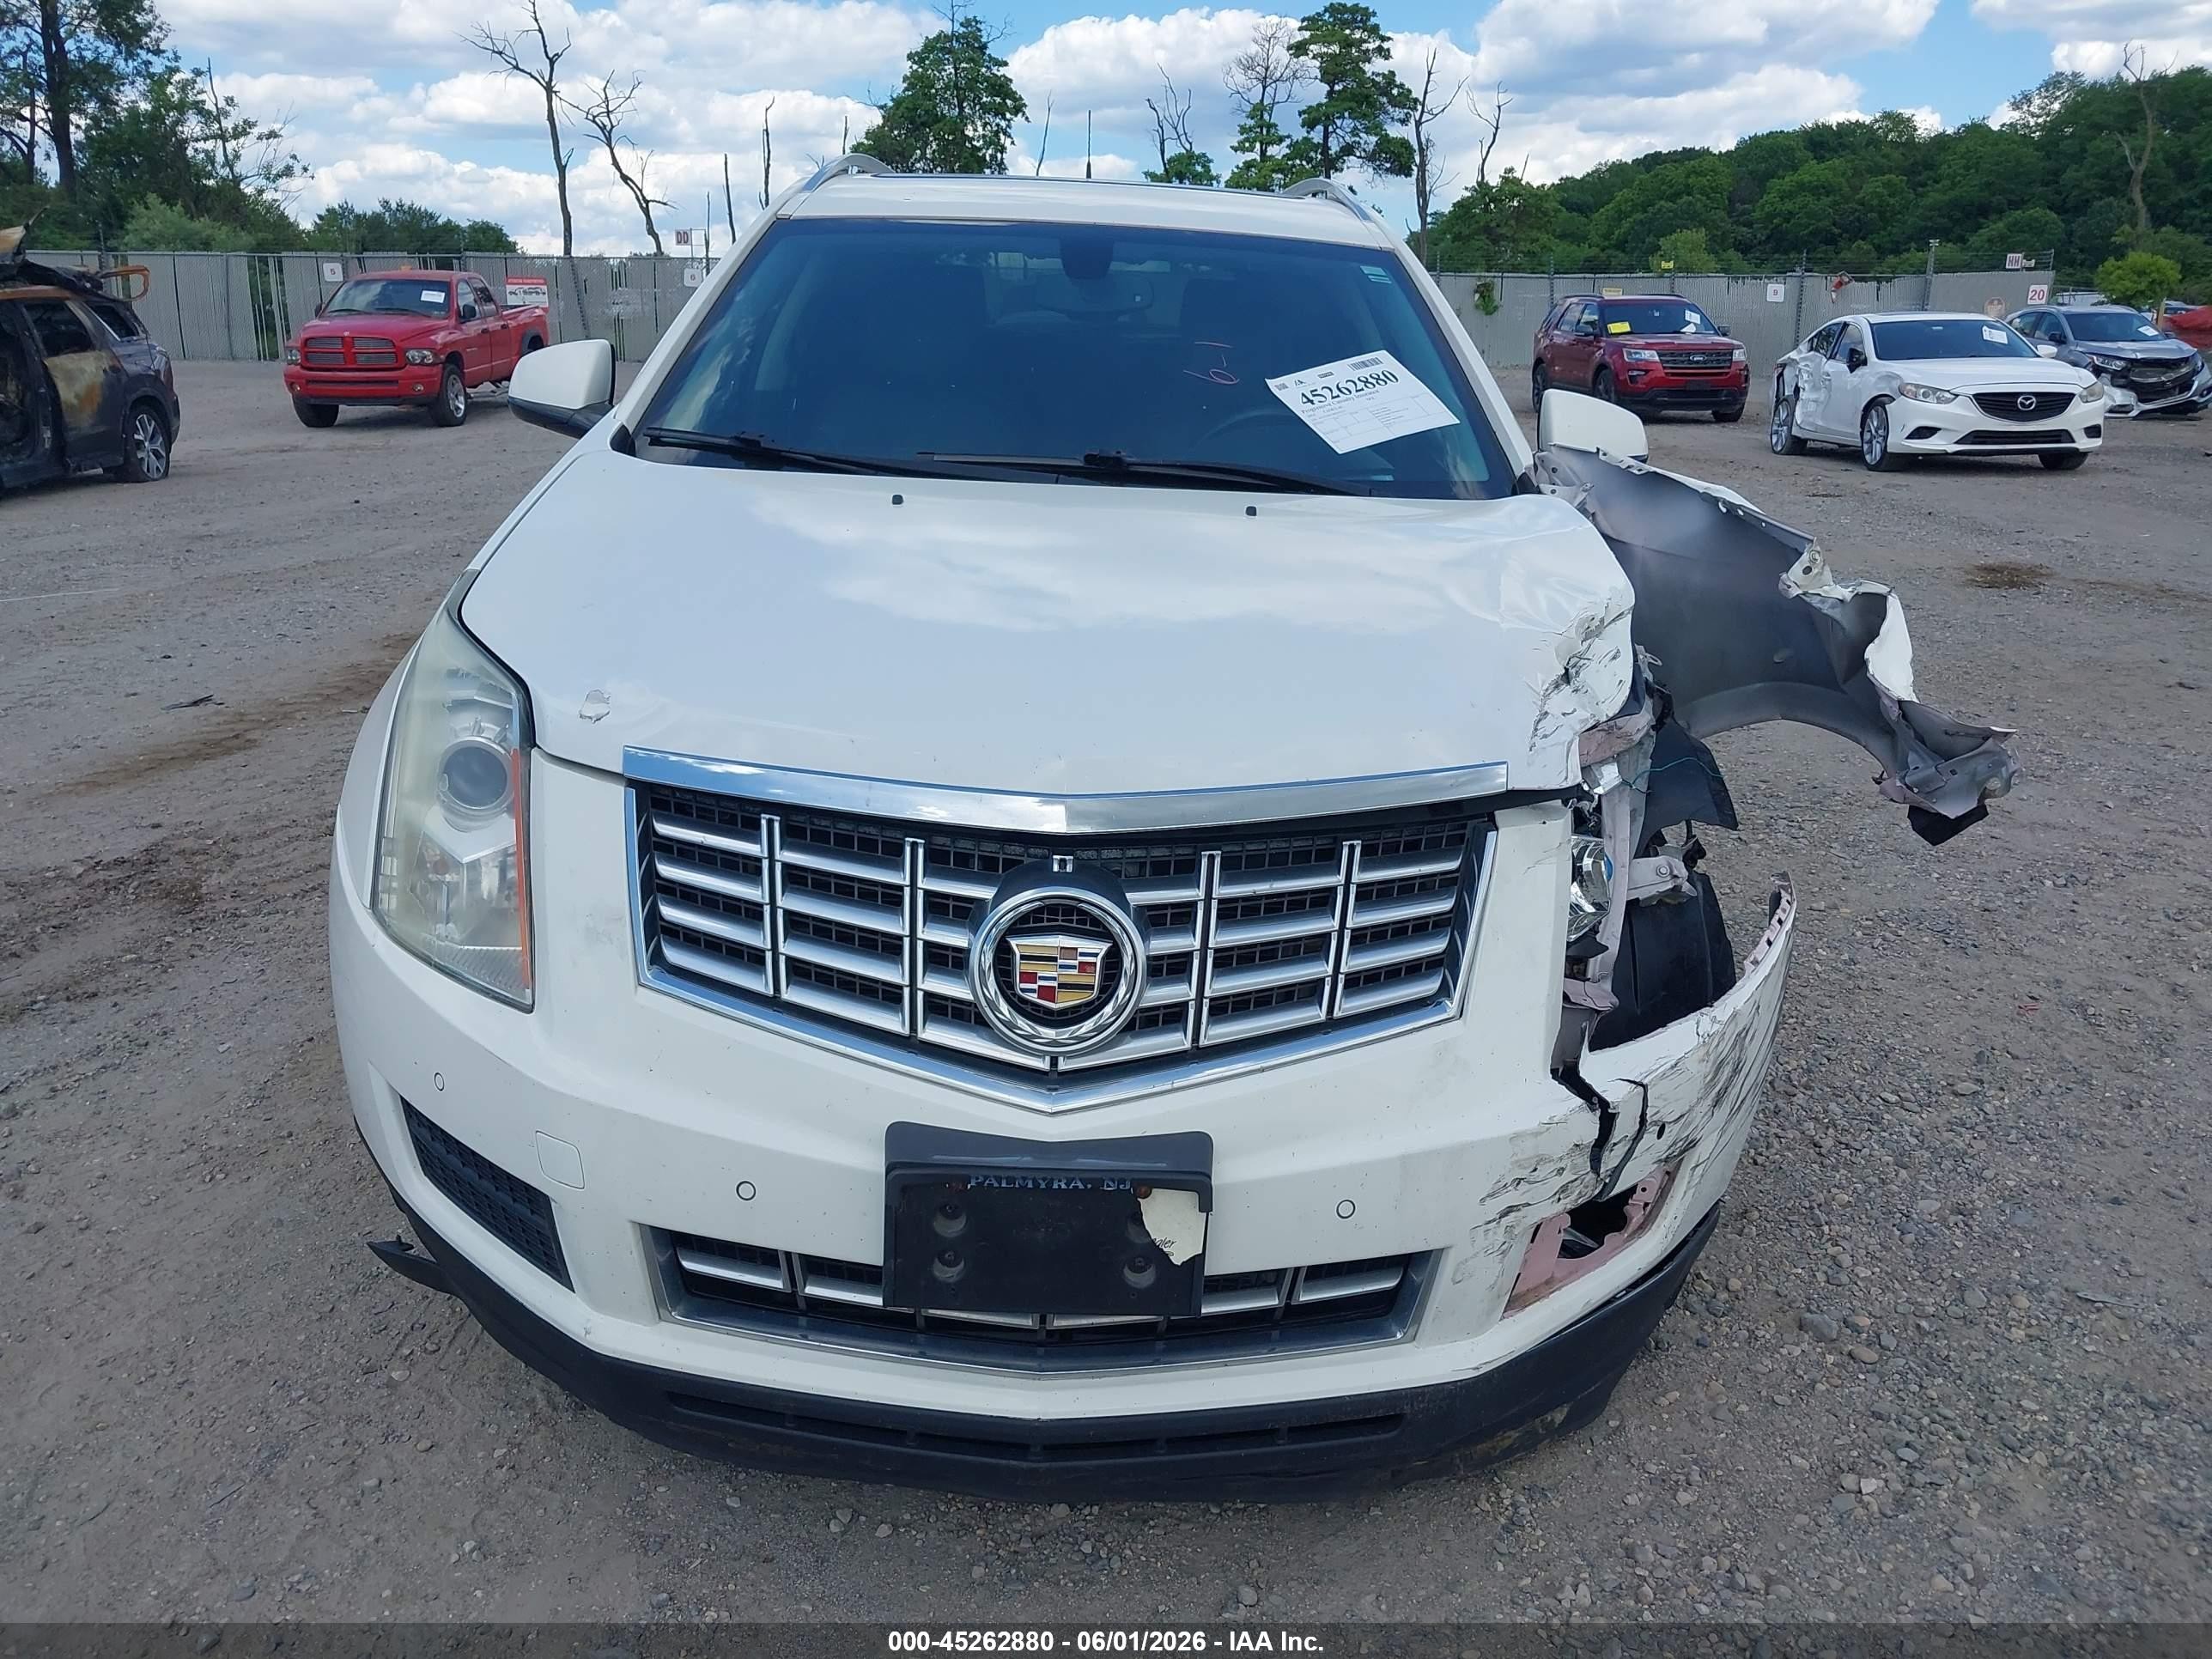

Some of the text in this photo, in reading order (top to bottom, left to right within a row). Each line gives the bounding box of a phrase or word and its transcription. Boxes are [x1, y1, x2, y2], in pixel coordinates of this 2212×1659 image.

[677, 231, 689, 244] DD
[2008, 255, 2021, 267] HH
[2029, 289, 2045, 301] 20
[1300, 369, 1399, 405] 45262880
